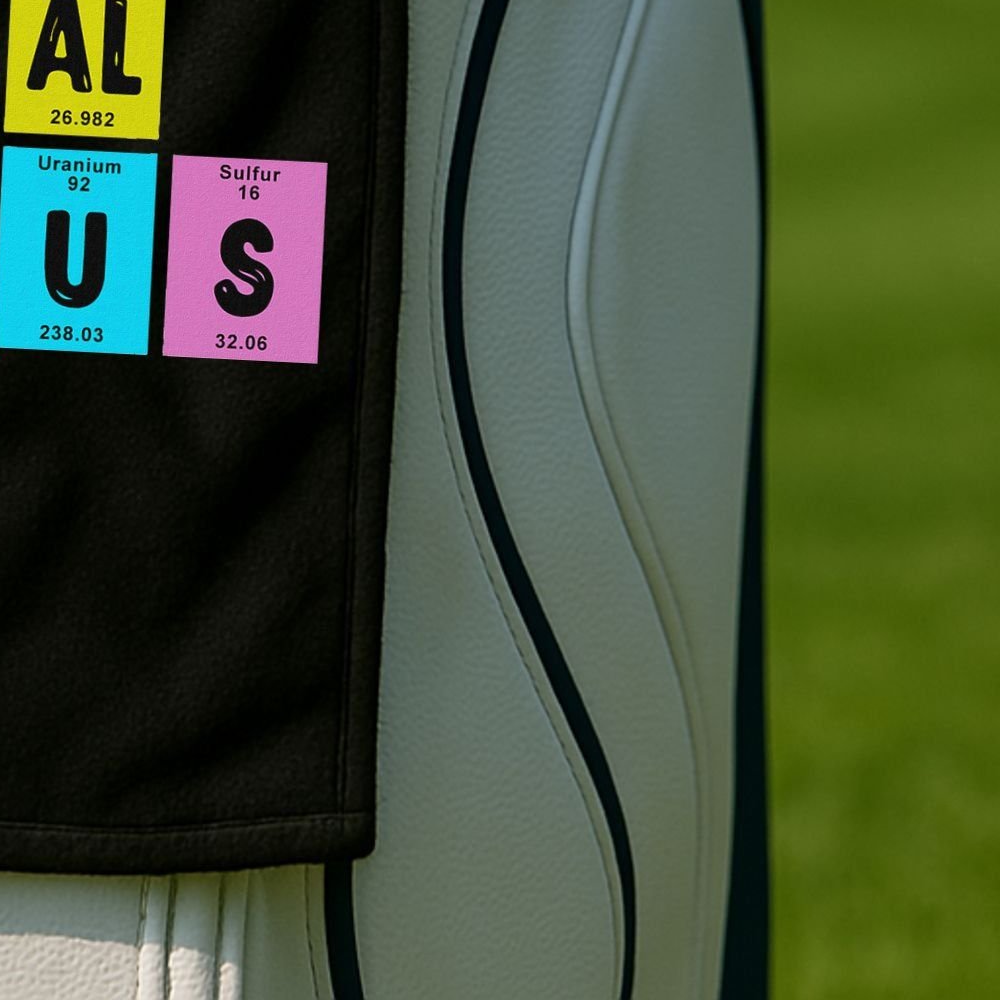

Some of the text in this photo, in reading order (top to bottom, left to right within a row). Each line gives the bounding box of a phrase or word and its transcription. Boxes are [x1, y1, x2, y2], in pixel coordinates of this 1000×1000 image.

[51, 110, 114, 127] 26.982
[39, 156, 120, 173] Uranium
[220, 165, 280, 181] Sulfur
[68, 176, 90, 191] 92
[239, 185, 259, 200] 16
[44, 210, 107, 308] U
[214, 218, 274, 317] S
[40, 325, 103, 342] 238.03
[216, 334, 267, 350] 32.06
